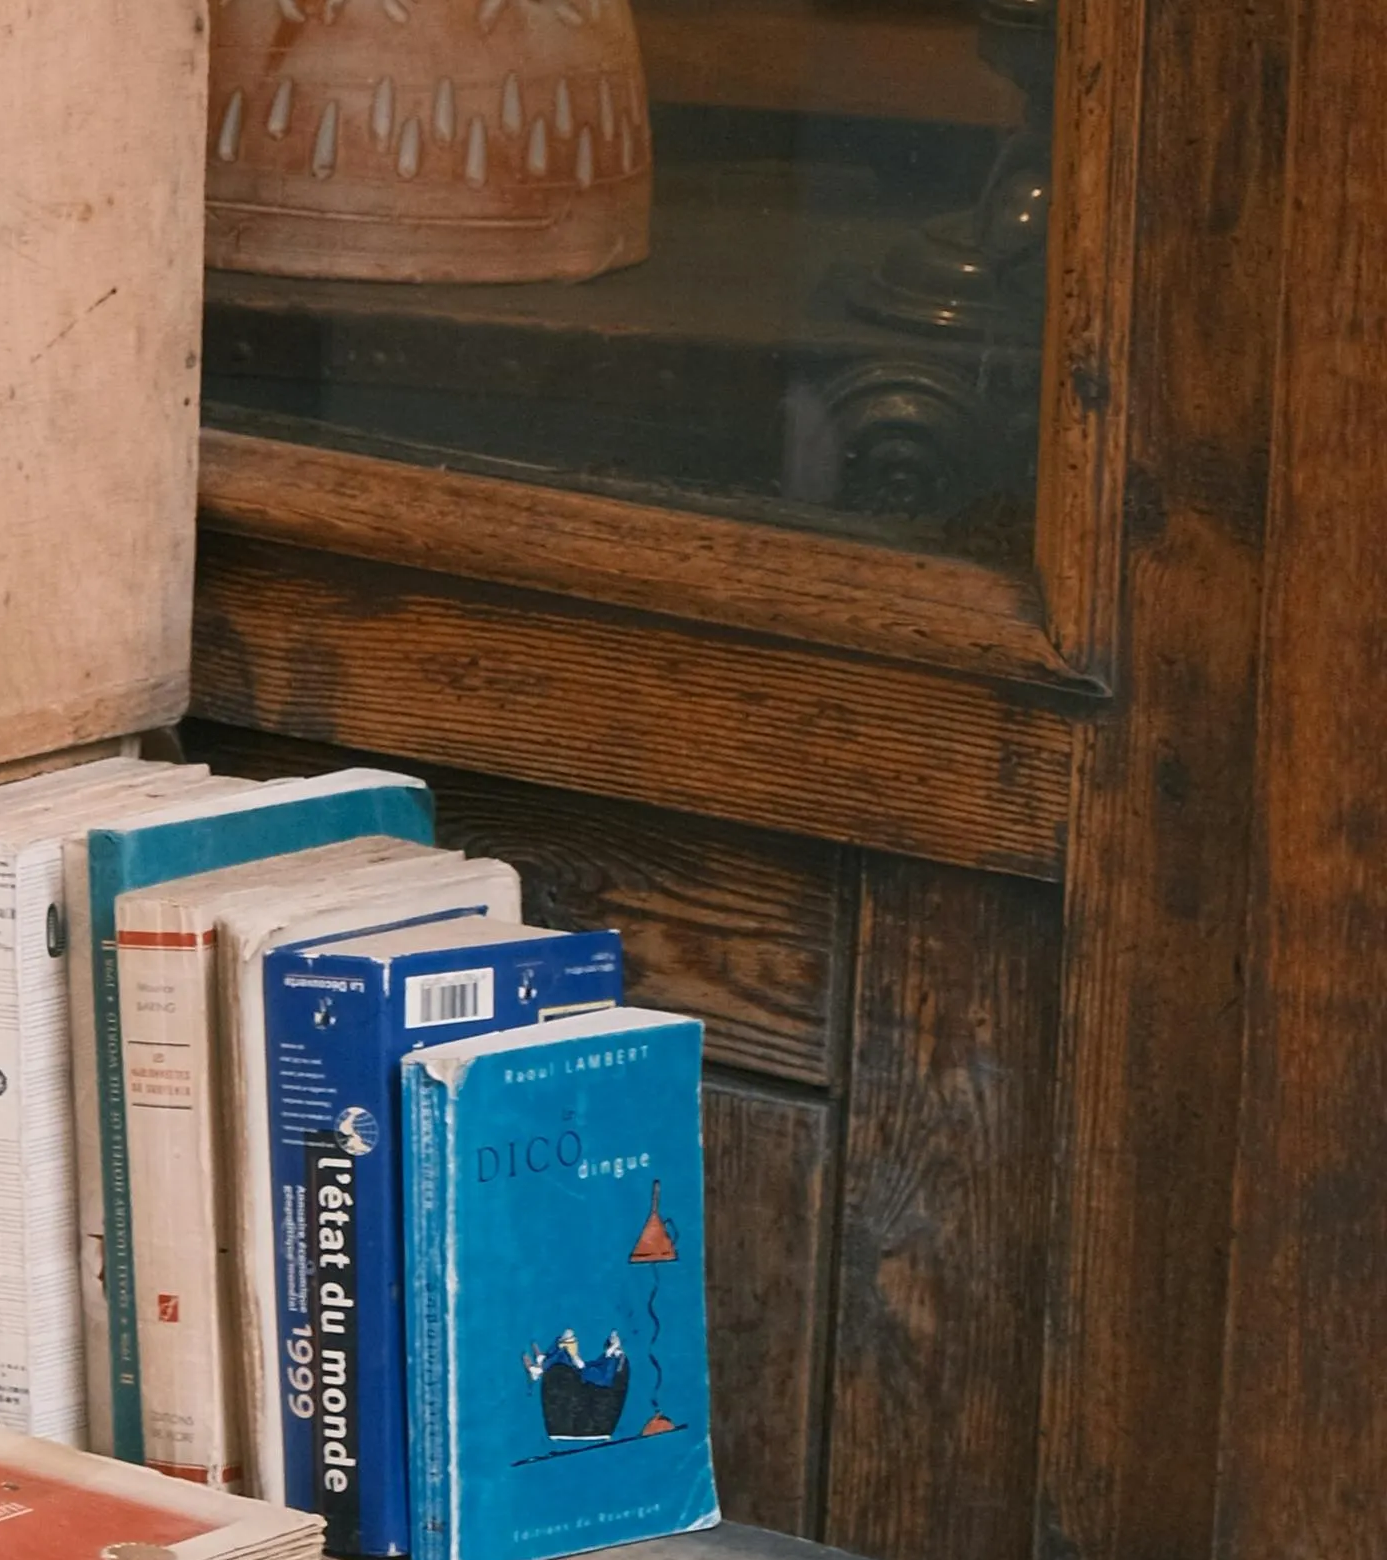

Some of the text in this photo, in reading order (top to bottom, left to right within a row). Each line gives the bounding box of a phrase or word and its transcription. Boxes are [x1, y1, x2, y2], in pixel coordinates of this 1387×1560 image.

[106, 1011, 119, 1069] WORLD
[504, 1046, 650, 1084] Raoul LAMBERT
[108, 1075, 121, 1103] THE
[109, 1110, 122, 1130] OF
[111, 1135, 125, 1193] HOTELS
[476, 1128, 583, 1183] DICO
[577, 1150, 651, 1180] dingue
[114, 1200, 127, 1258] LUXURY
[295, 1185, 308, 1240] Annuaire
[318, 1282, 354, 1334] du
[287, 1323, 314, 1420] 1999
[322, 1350, 357, 1494] monde
